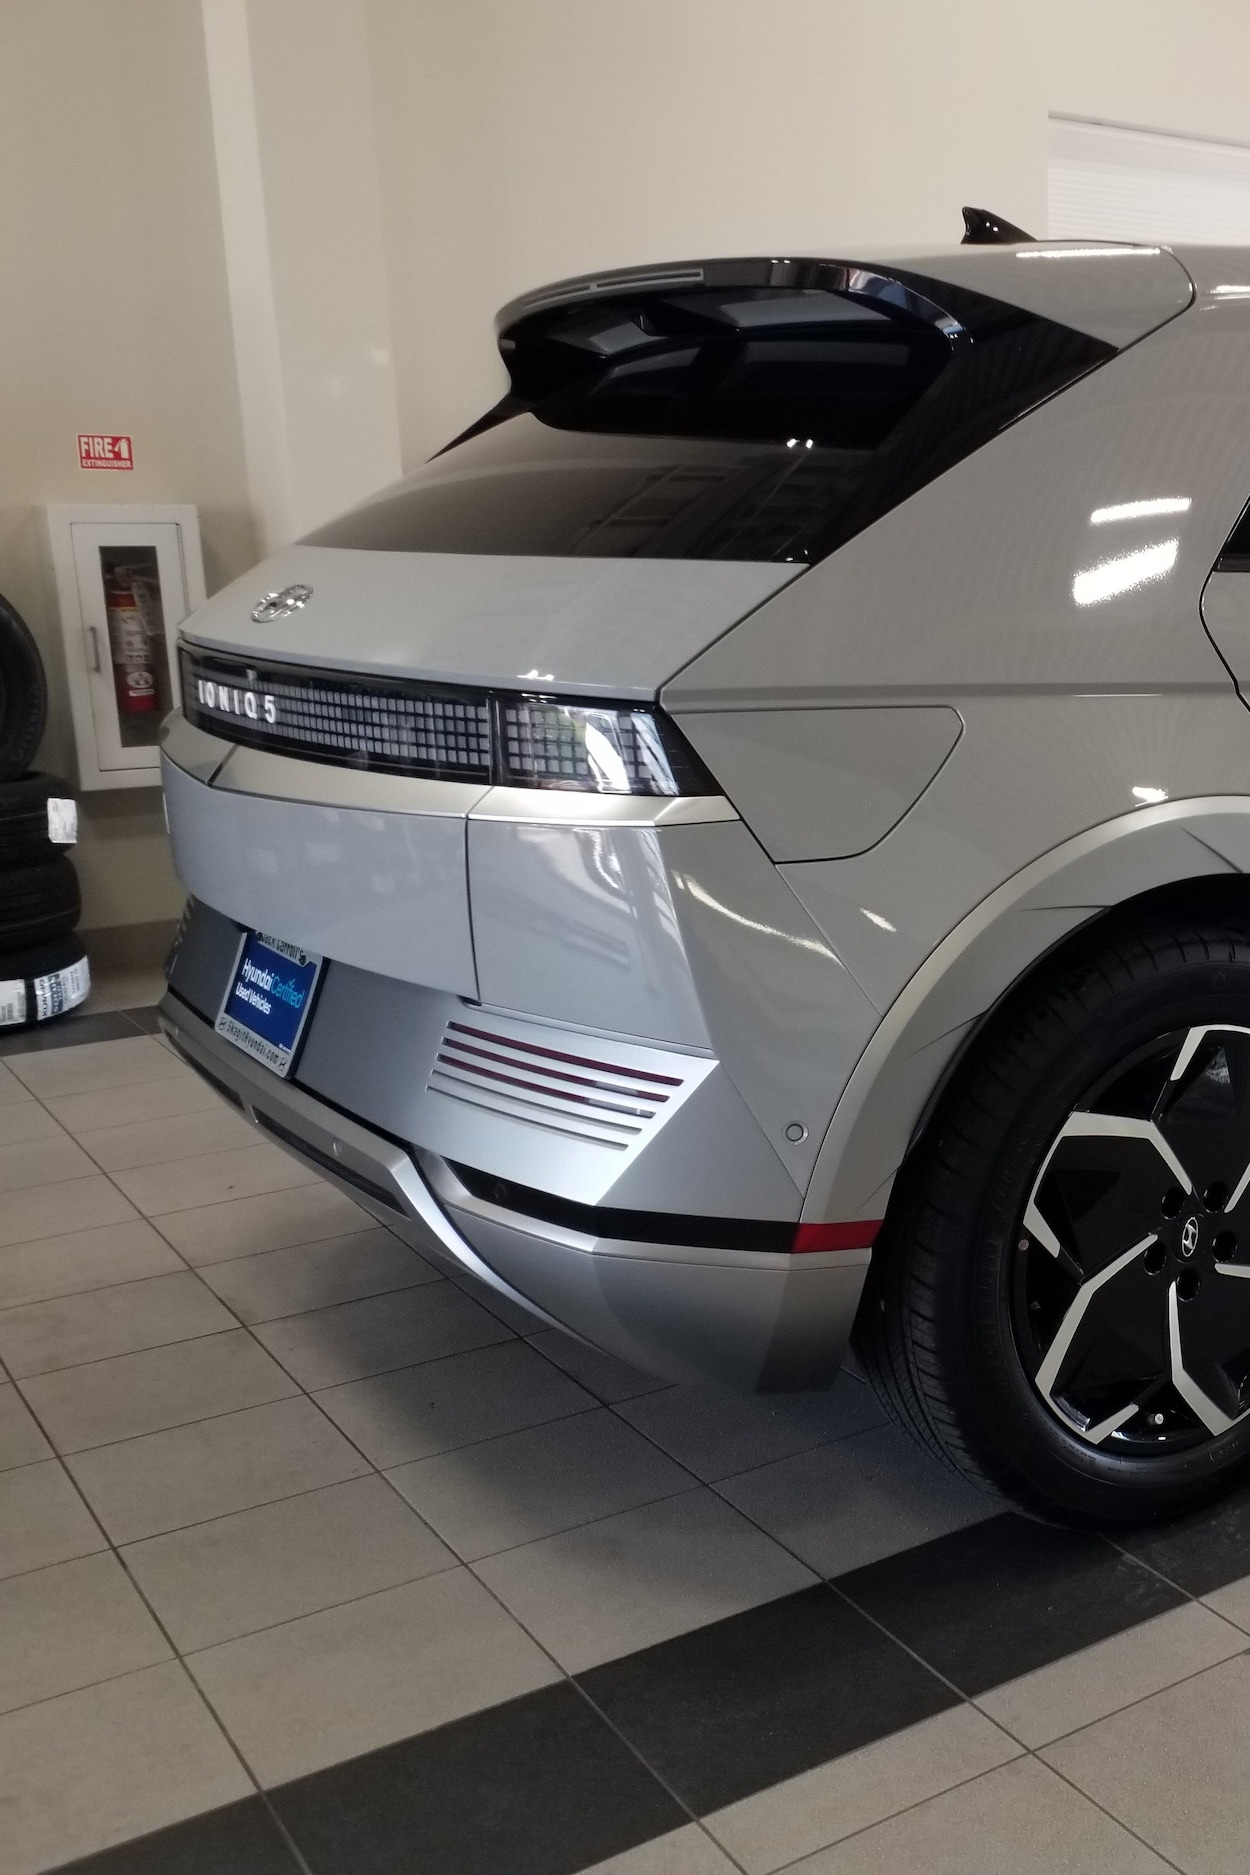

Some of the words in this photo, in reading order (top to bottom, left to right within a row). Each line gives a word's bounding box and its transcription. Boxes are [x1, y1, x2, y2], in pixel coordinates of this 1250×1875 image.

[80, 437, 114, 459] FIRE
[81, 459, 132, 468] EXTINGUISHER
[198, 680, 258, 720] IONIQ
[264, 694, 277, 724] 5
[235, 981, 250, 1000] Used
[249, 987, 272, 1015] Vehicles
[241, 958, 275, 991] Hyundai
[271, 976, 305, 1009] Certified
[226, 1021, 280, 1065] SkagitHyundai.com
